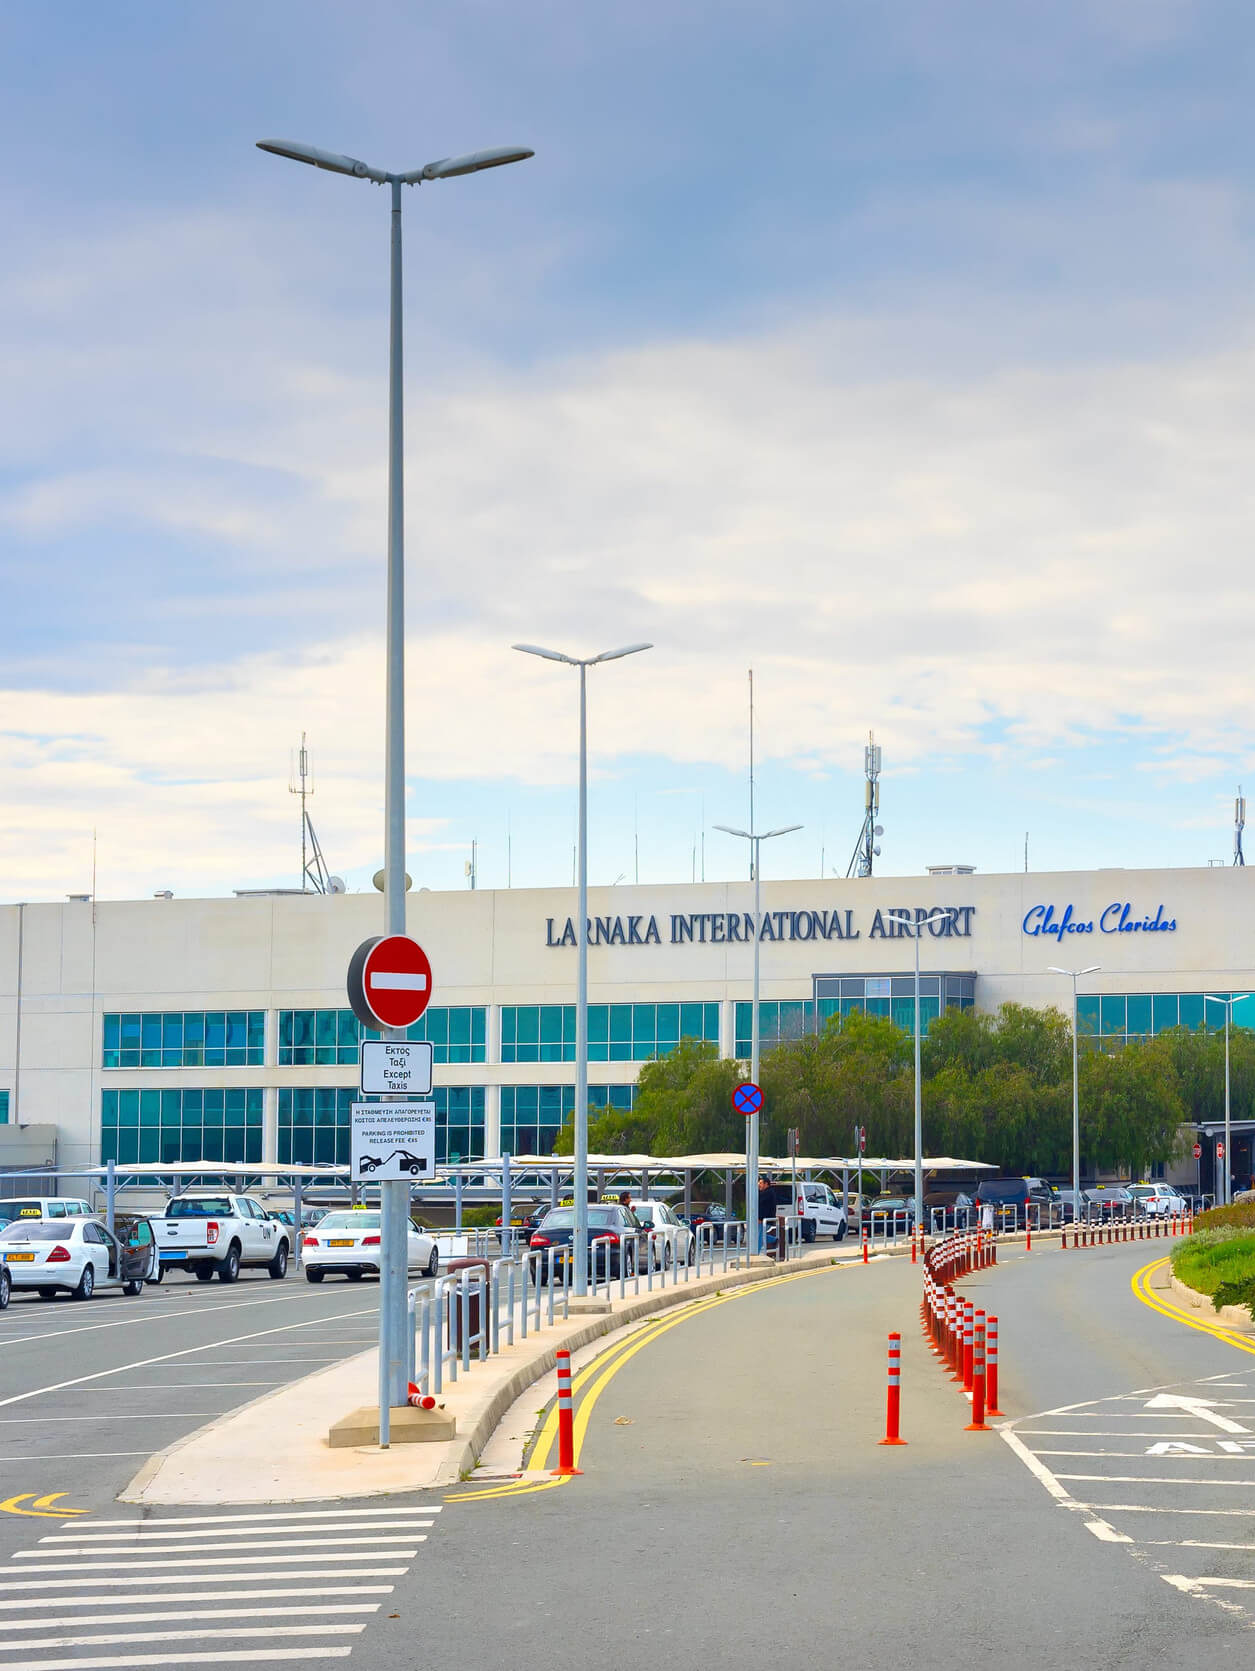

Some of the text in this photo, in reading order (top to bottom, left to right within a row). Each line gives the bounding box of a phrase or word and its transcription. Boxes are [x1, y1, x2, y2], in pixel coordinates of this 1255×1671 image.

[545, 906, 976, 947] LARNAKA INTERNATIONAL AIRPORT
[1022, 902, 1177, 942] Glafcos Clerides
[383, 1069, 411, 1080] Except
[388, 1081, 408, 1089] Taxis
